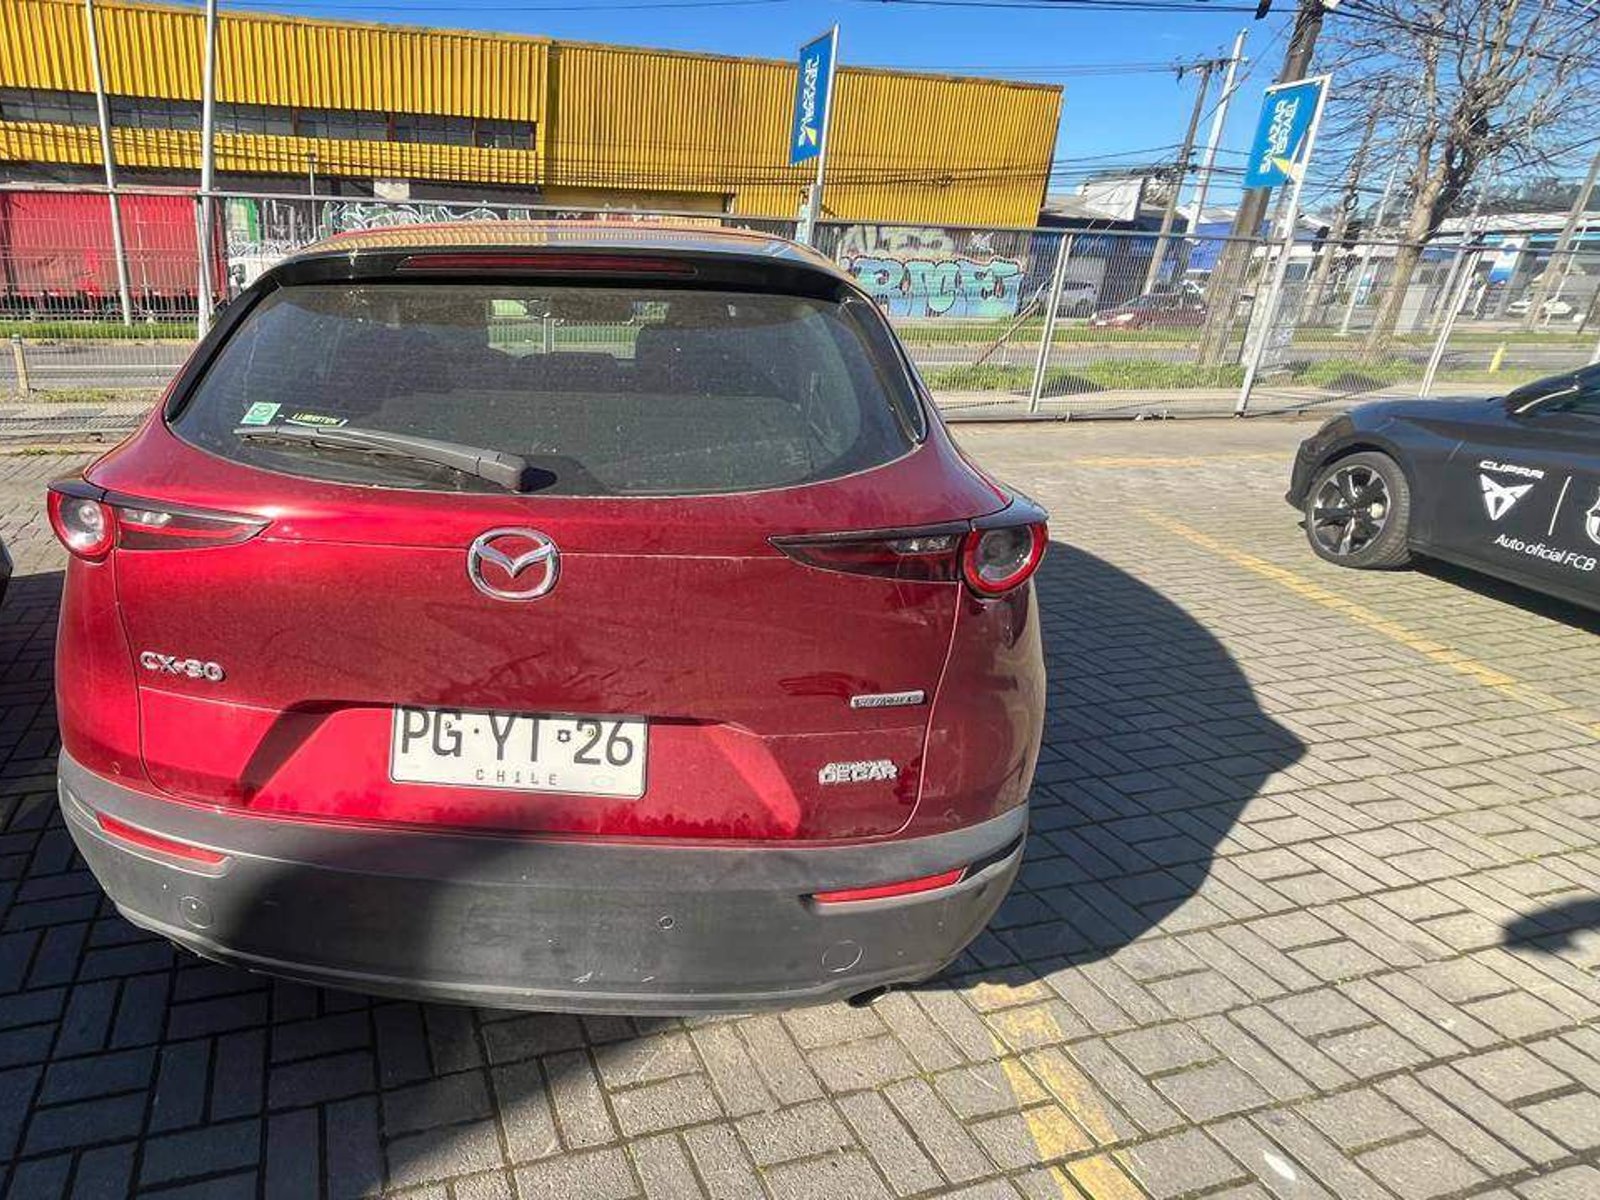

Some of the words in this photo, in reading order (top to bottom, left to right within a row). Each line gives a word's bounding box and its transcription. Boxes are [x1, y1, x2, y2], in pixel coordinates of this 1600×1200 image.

[1259, 99, 1289, 174] SALAZAR
[1275, 97, 1300, 154] ISRAEL
[1479, 460, 1545, 479] CUPRA
[1494, 533, 1525, 551] Auto
[1524, 542, 1567, 563] oficial
[1562, 552, 1597, 571] FCB
[475, 768, 558, 786] CHILE
